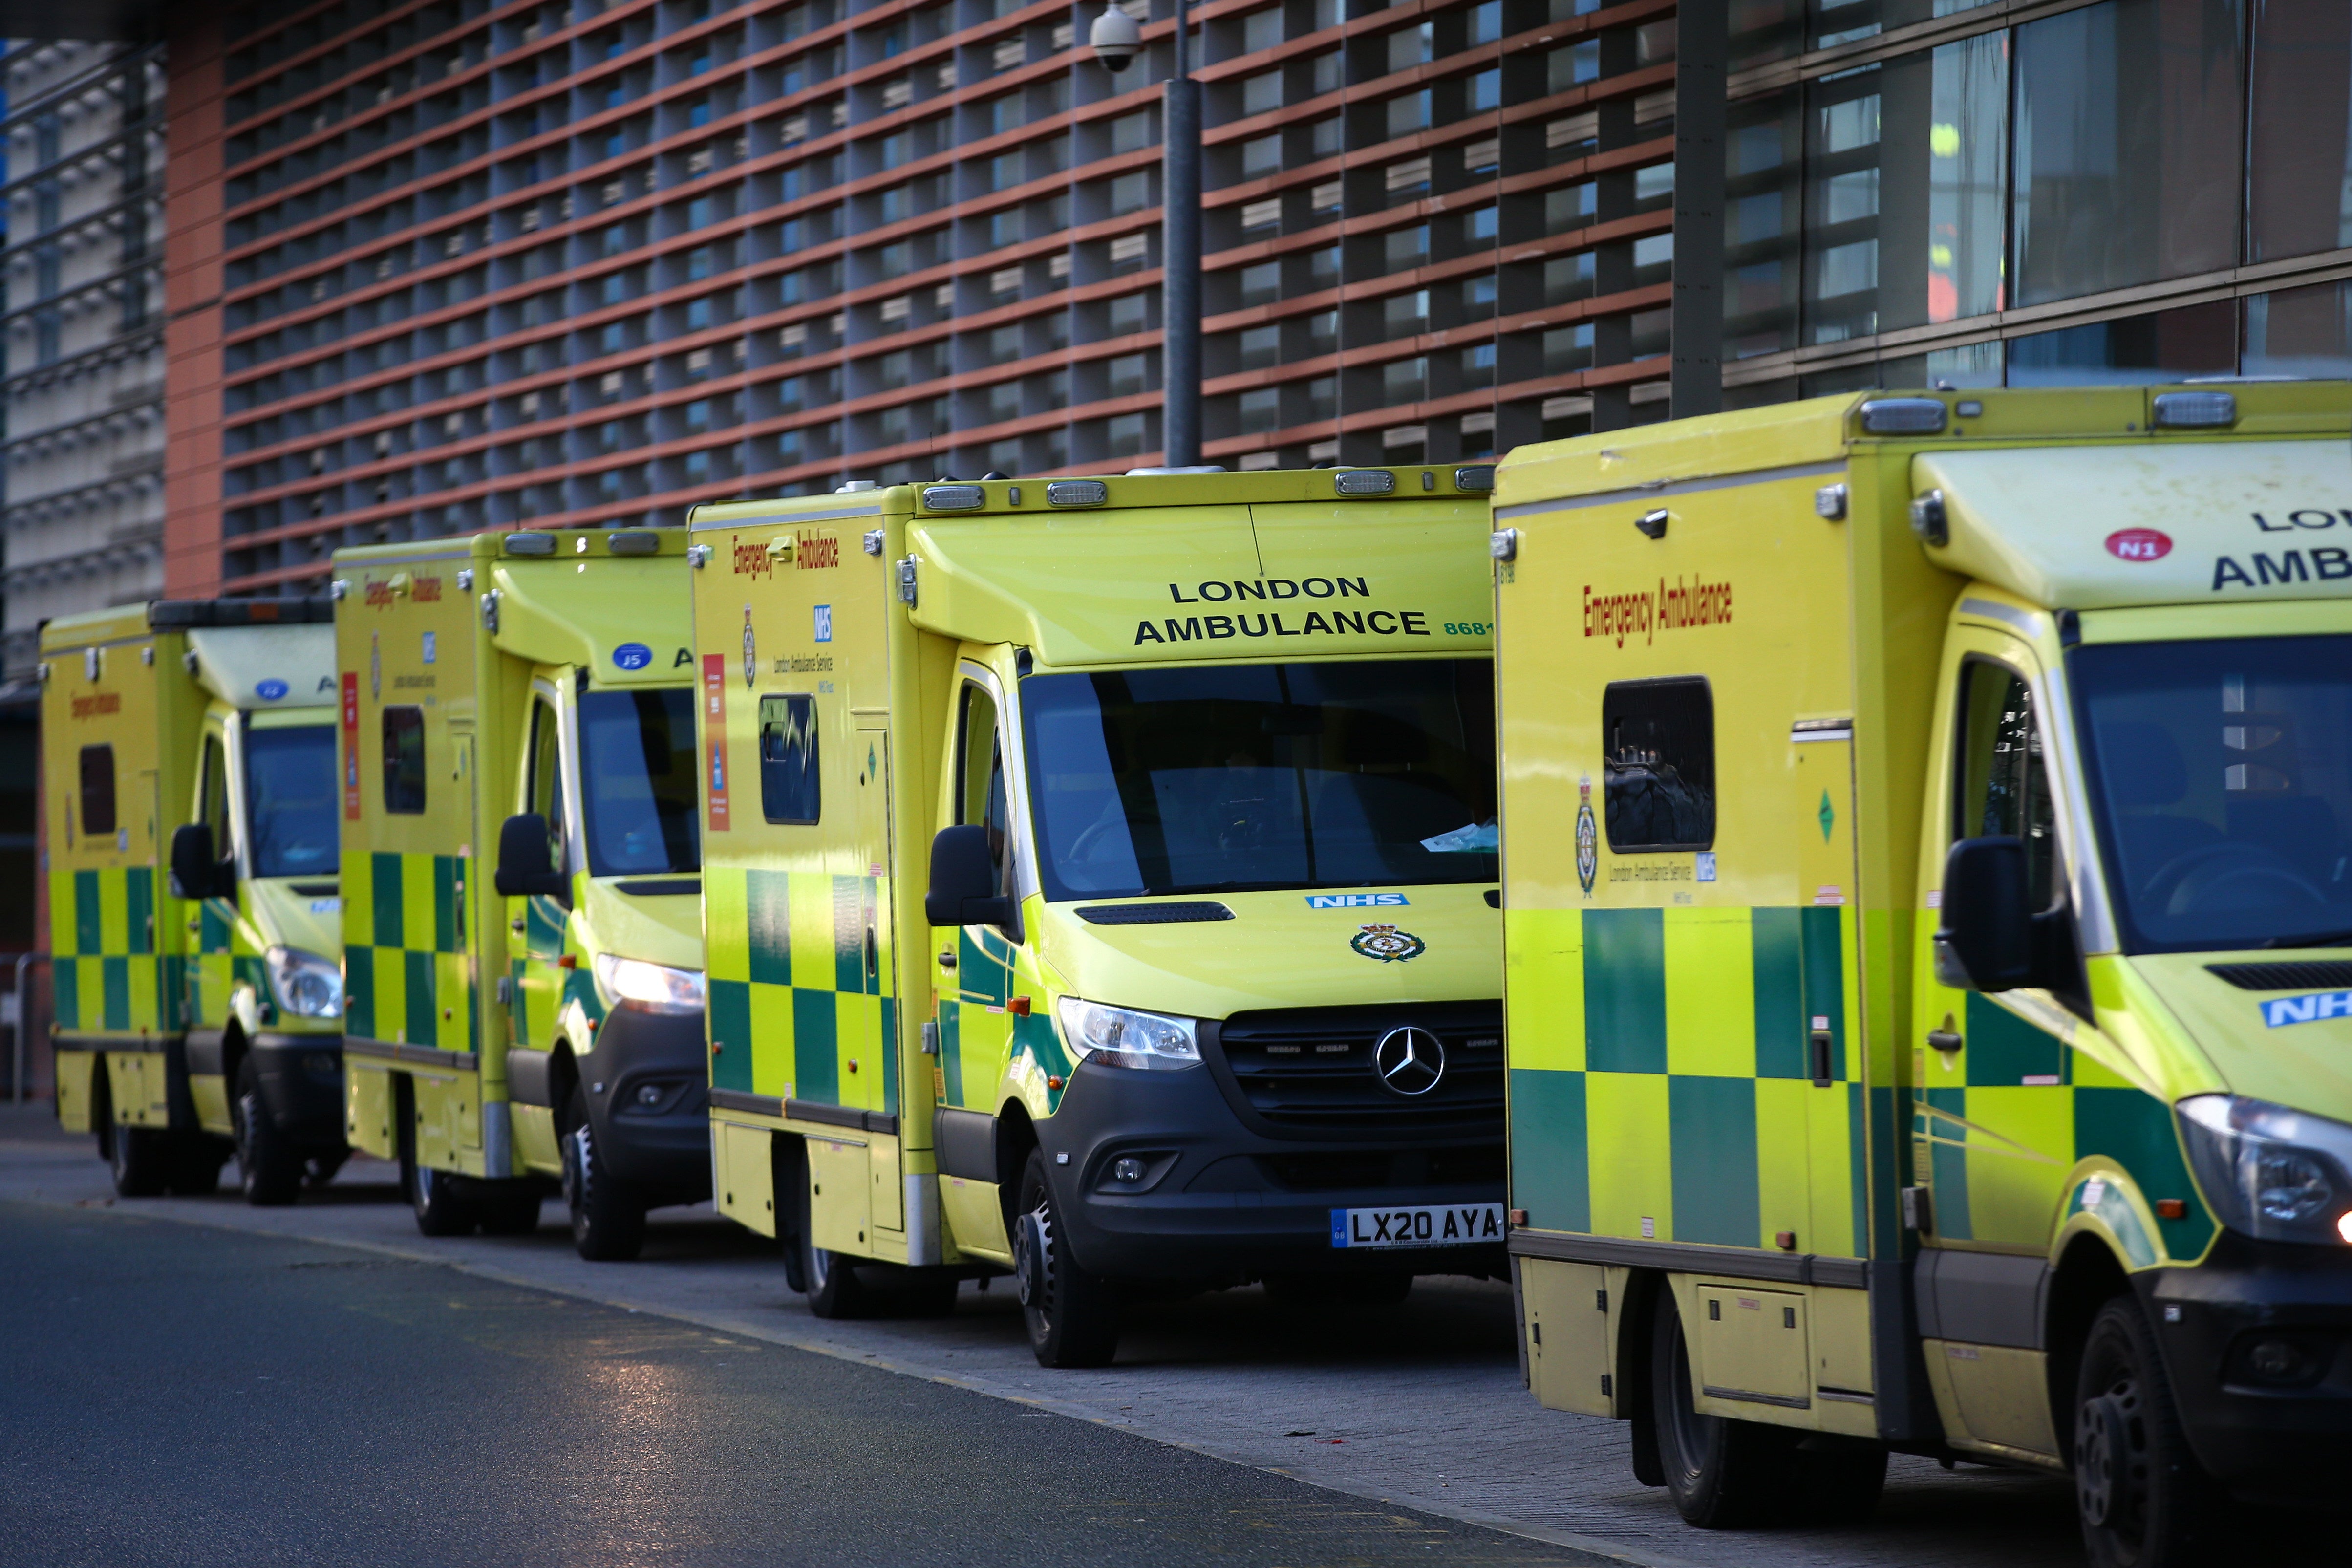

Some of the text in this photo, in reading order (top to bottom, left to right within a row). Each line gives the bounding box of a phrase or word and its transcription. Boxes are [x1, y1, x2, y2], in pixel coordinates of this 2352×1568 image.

[797, 528, 838, 569] Ambulance
[2118, 541, 2157, 557] N1
[2211, 548, 2352, 590] AMB
[1169, 577, 1370, 603] LONDON
[814, 607, 831, 640] NHS
[1584, 572, 1732, 648] Emergency Ambulance
[1134, 610, 1431, 645] AMBULANCE
[623, 655, 641, 667] J5
[1697, 855, 1716, 880] NHS
[1313, 894, 1402, 908] NHS
[1352, 1208, 1499, 1242] LX20 AYA
